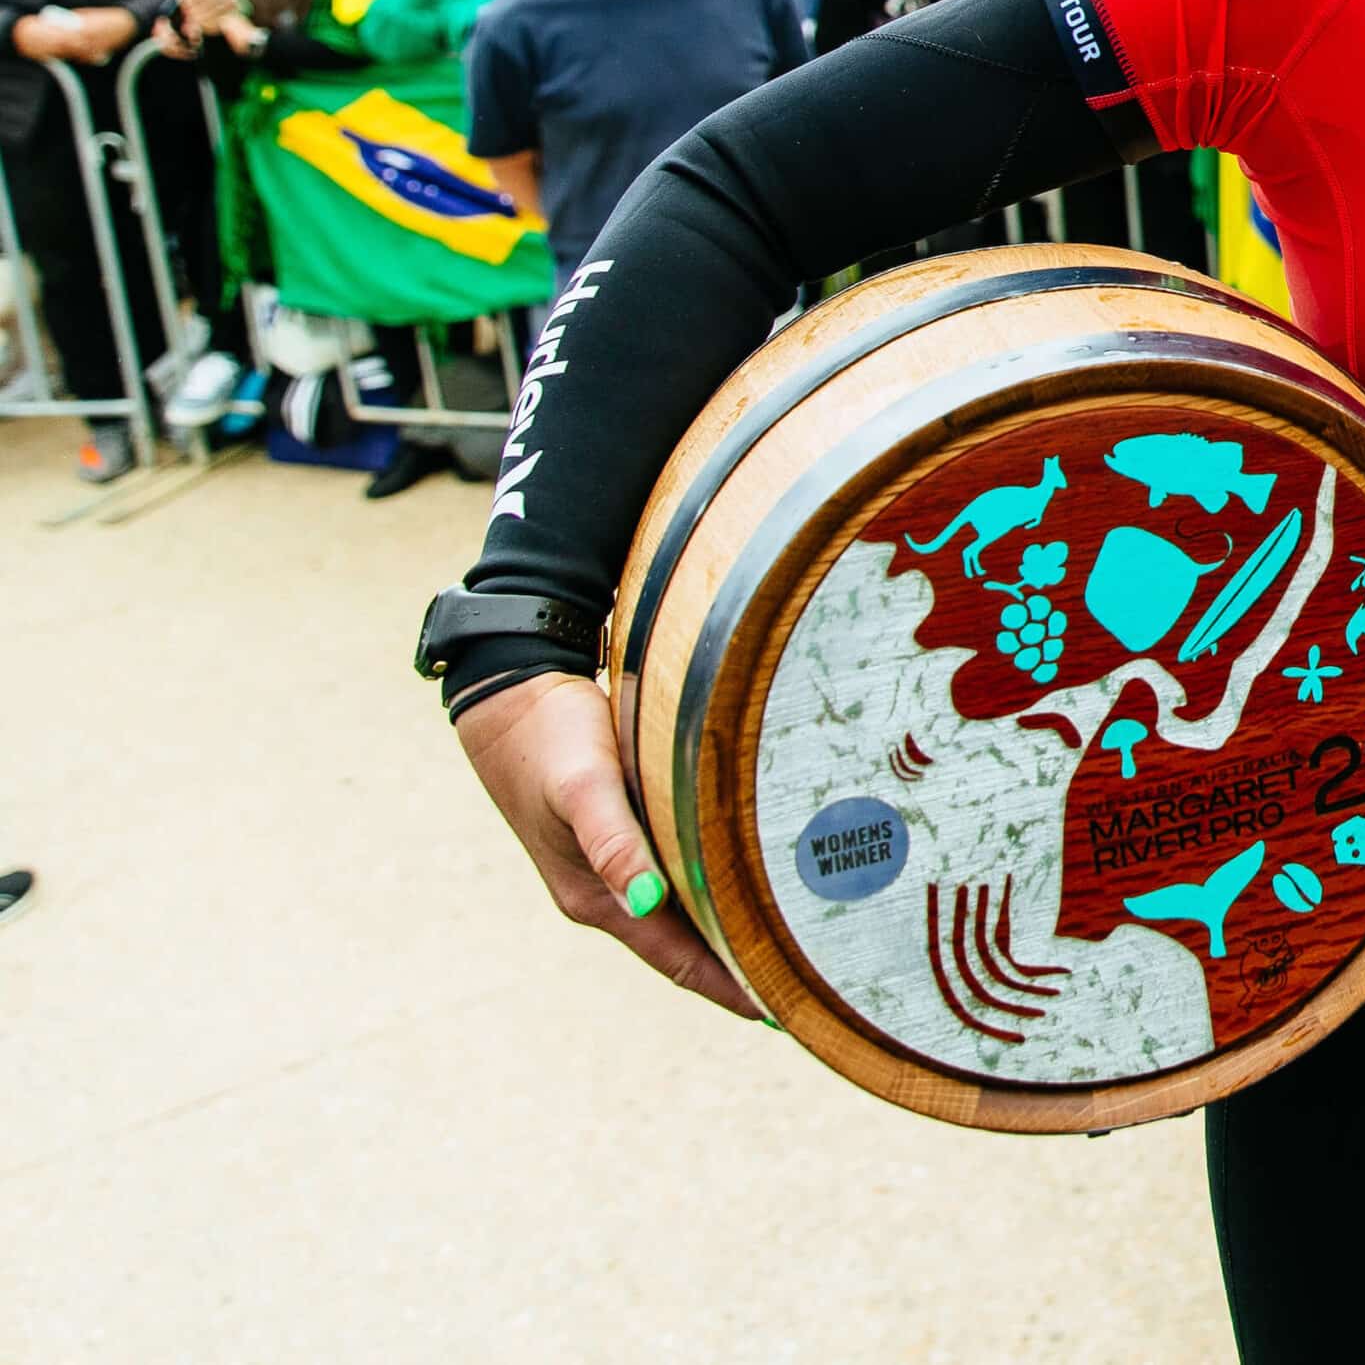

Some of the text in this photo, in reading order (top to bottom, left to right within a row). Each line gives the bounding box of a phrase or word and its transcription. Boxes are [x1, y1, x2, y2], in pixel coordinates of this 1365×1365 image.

[502, 258, 616, 460] Hurley
[810, 820, 893, 858] WOMENS
[1088, 764, 1303, 845] MARGARET
[1092, 801, 1285, 874] RIVER PRO
[817, 842, 893, 877] WINNER
